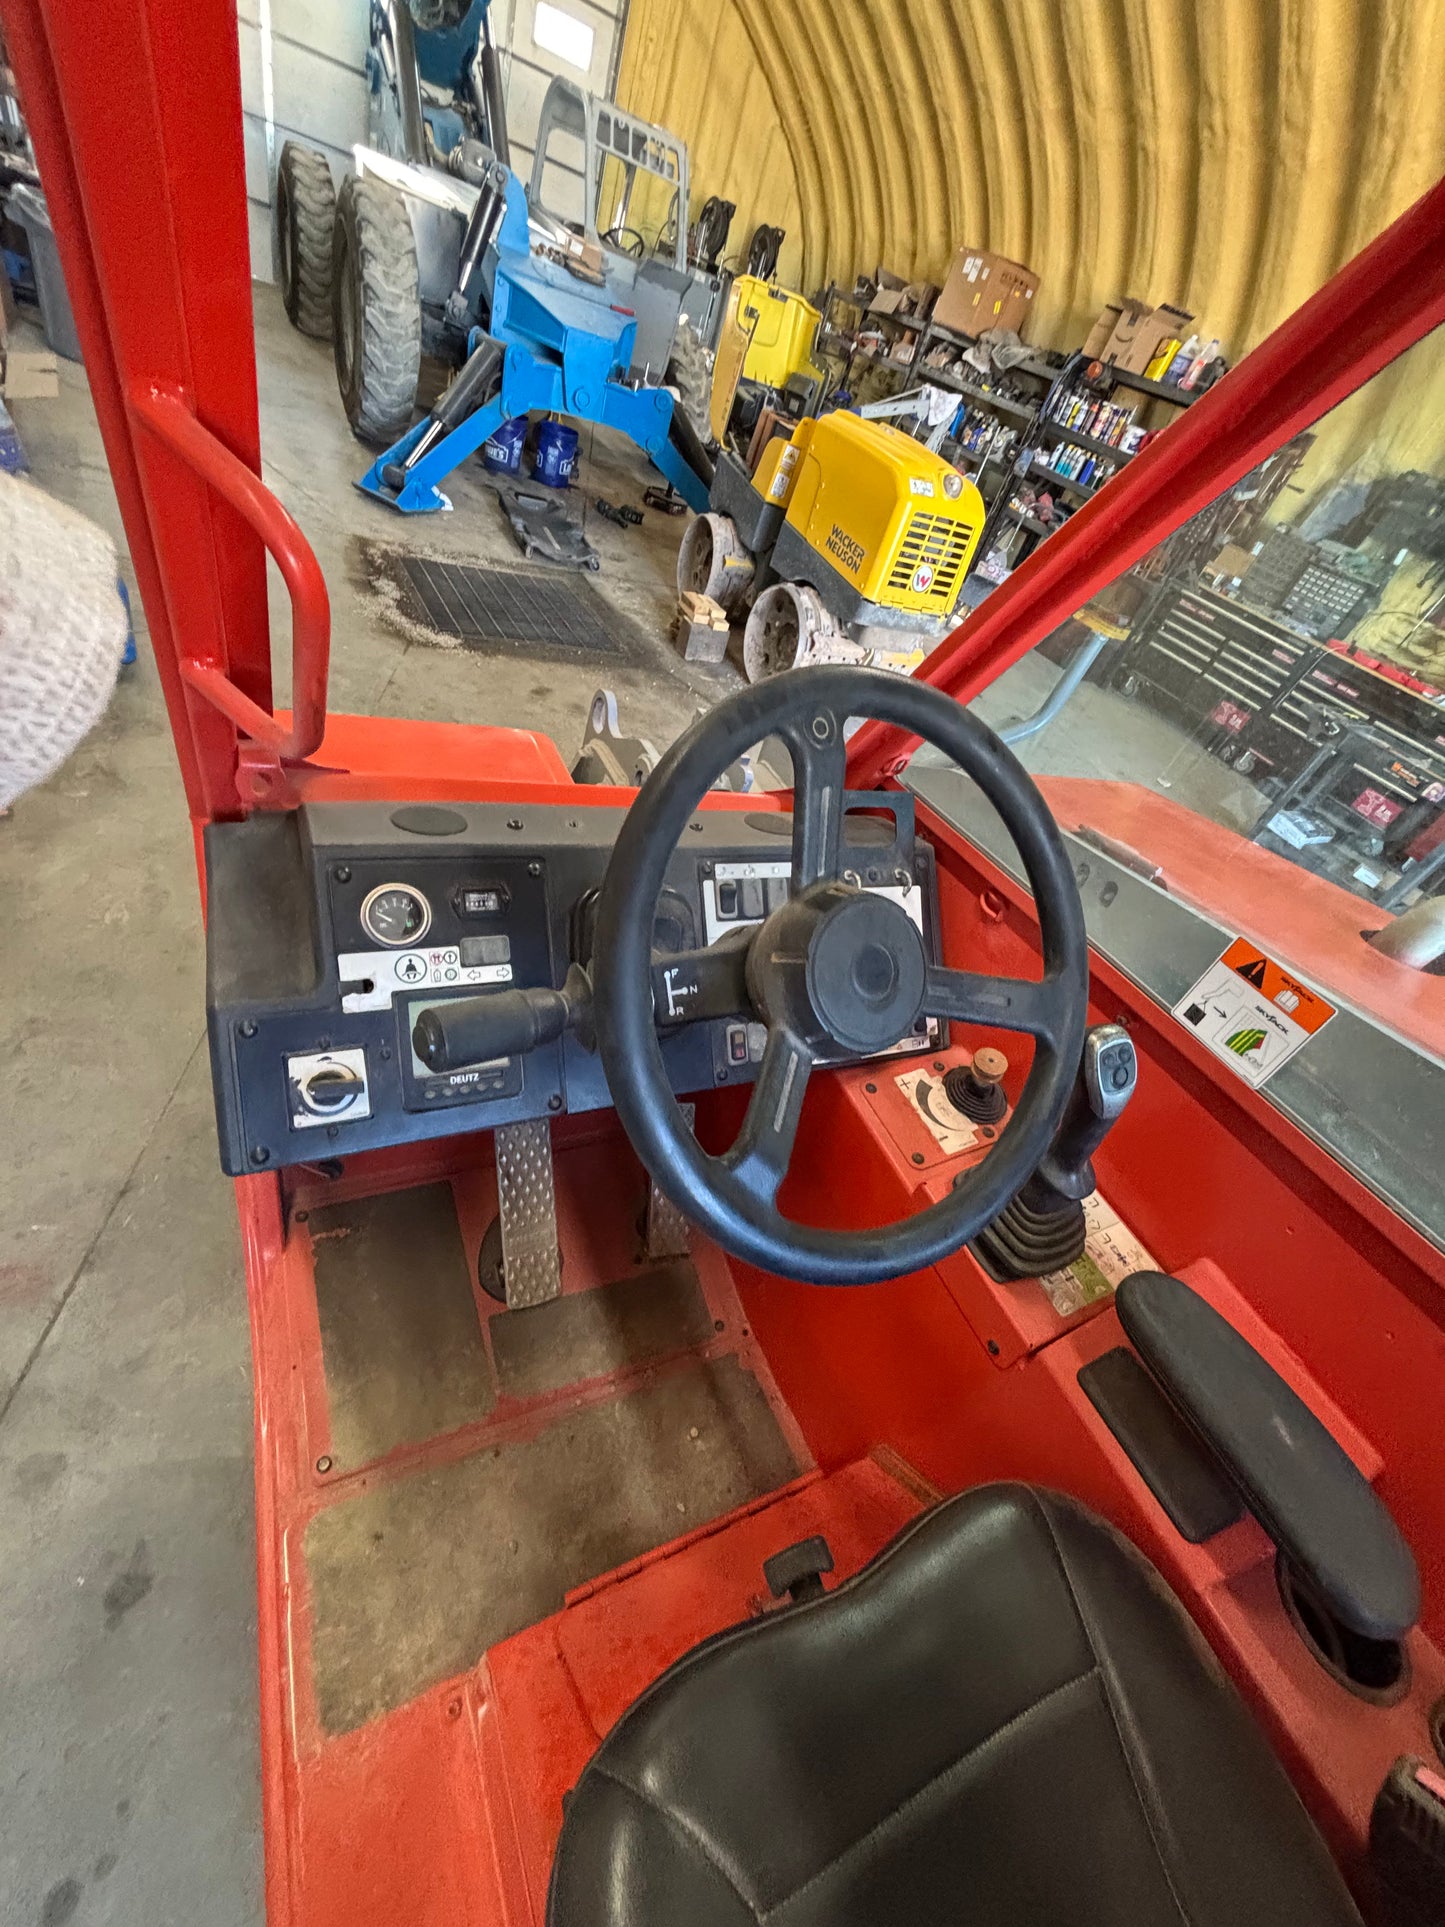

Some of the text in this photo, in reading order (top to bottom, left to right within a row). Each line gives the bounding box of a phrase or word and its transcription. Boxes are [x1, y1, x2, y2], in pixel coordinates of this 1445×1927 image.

[831, 523, 866, 562] WACKER
[825, 536, 861, 574] NEUSON
[671, 968, 679, 979] F
[689, 984, 698, 995] N
[1280, 976, 1315, 1004] SKYJACK
[676, 1006, 685, 1016] R
[1255, 1005, 1289, 1035] SKYJACK
[449, 1073, 480, 1085] DEUTZ
